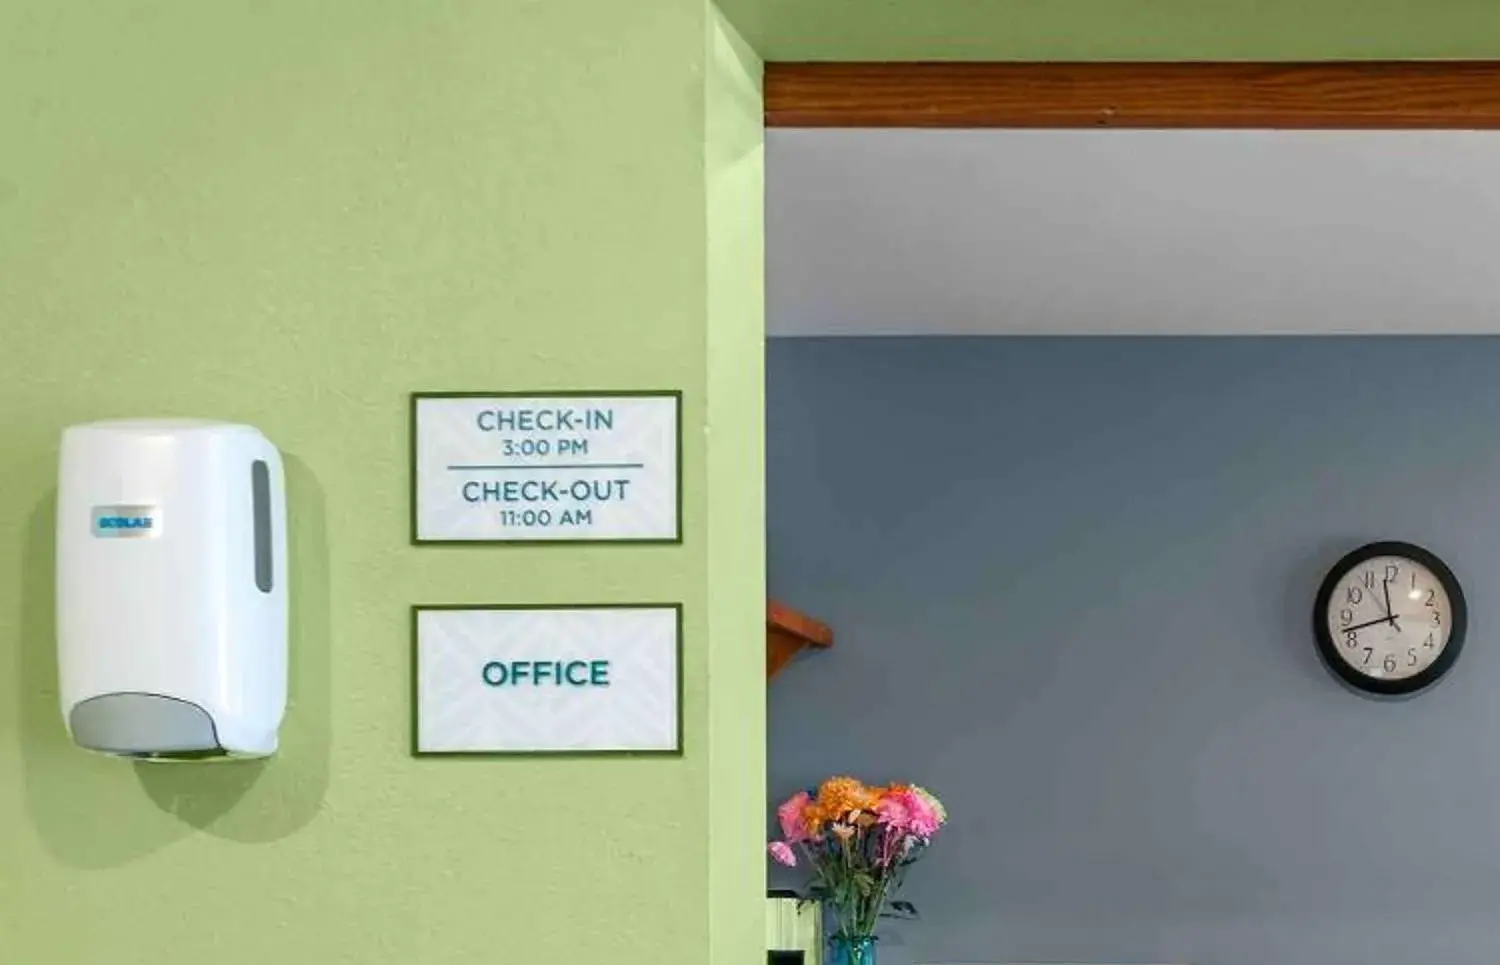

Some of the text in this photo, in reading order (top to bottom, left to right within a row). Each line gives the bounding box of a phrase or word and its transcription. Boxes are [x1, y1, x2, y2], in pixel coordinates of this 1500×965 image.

[477, 409, 614, 432] CHECK-IN
[502, 438, 589, 457] 3:00 PM
[461, 479, 631, 503] CHECK-OUT
[500, 508, 593, 527] 11:00 AM
[1365, 570, 1375, 588] 11
[1346, 586, 1362, 604] 10
[1424, 588, 1435, 606] 2
[1340, 608, 1352, 626] 9
[1431, 610, 1441, 628] 3
[1345, 630, 1357, 648] 8
[1422, 631, 1434, 649] 4
[1362, 646, 1373, 664] 7
[1383, 653, 1396, 672] 6
[1406, 647, 1417, 666] 5
[481, 659, 611, 689] OFFICE
